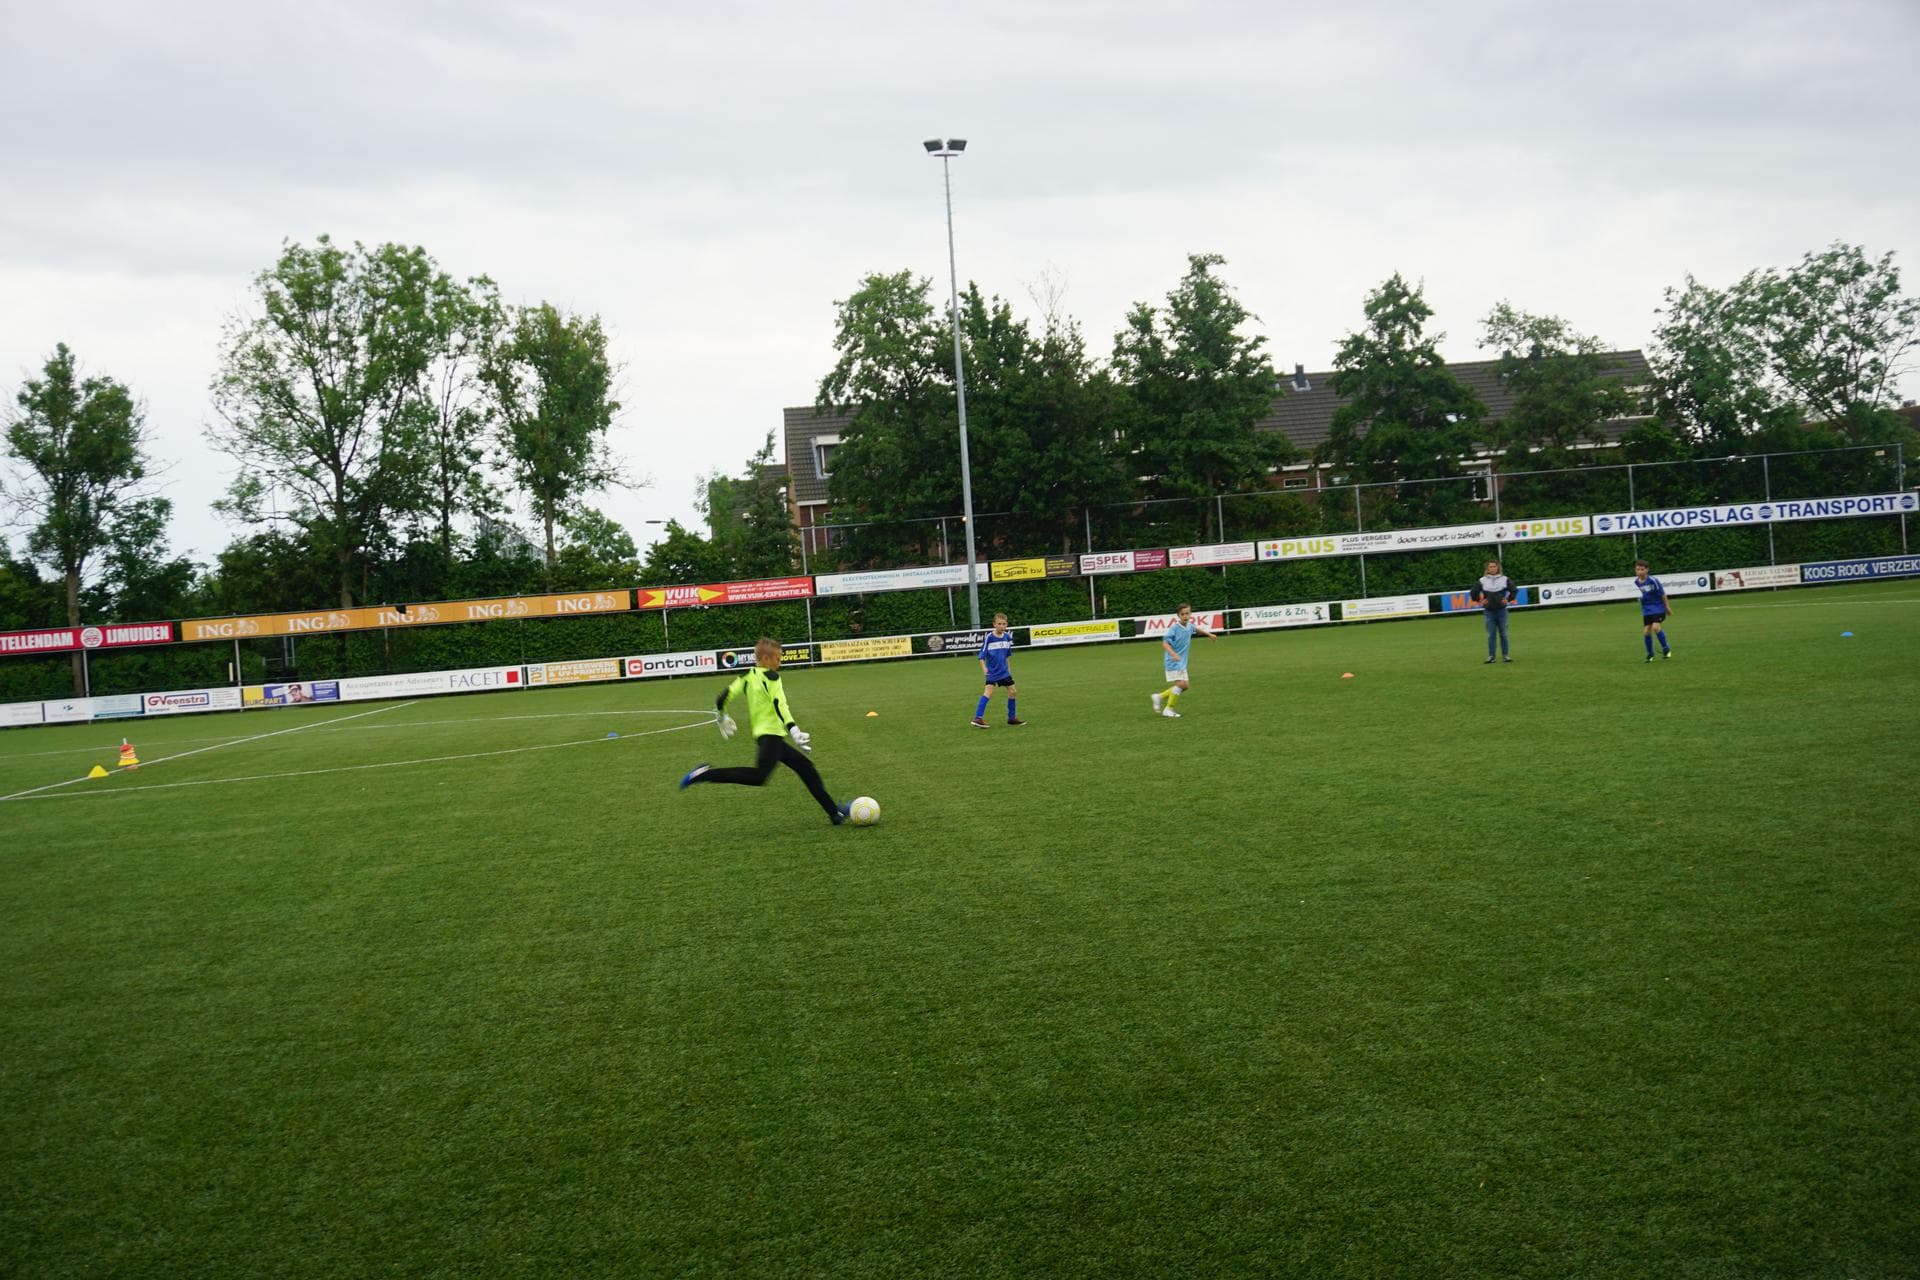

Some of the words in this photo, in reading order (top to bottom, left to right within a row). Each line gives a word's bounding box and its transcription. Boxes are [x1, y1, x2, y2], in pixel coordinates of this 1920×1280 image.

[1776, 496, 1897, 518] TRANSPORT
[1615, 506, 1754, 530] TANKOPSLAG
[1531, 520, 1584, 536] PLUS
[1361, 534, 1393, 542] VERGEER
[1420, 533, 1449, 544] scoort
[1281, 539, 1336, 556] PLUS
[1096, 555, 1128, 565] SPEK
[1004, 566, 1028, 578] Spek
[1804, 566, 1835, 580] KOOS
[1837, 563, 1868, 577] ROOK
[1872, 558, 1920, 574] VERZEK
[665, 587, 699, 600] VUIK
[1555, 587, 1565, 596] de
[1567, 584, 1615, 596] Onderlingen
[467, 604, 503, 619] ING
[556, 598, 592, 612] ING
[378, 609, 414, 625] ING
[1244, 612, 1253, 620] P.
[1255, 608, 1282, 619] Visser
[1285, 608, 1292, 616] &
[1295, 607, 1310, 616] Zn.
[197, 623, 233, 638] ING
[287, 616, 324, 632] ING
[1034, 622, 1109, 638] ACCUCENTRALE
[0, 632, 74, 651] TELLENDAM
[106, 626, 170, 644] IJMUIDEN
[449, 671, 502, 689] FACET
